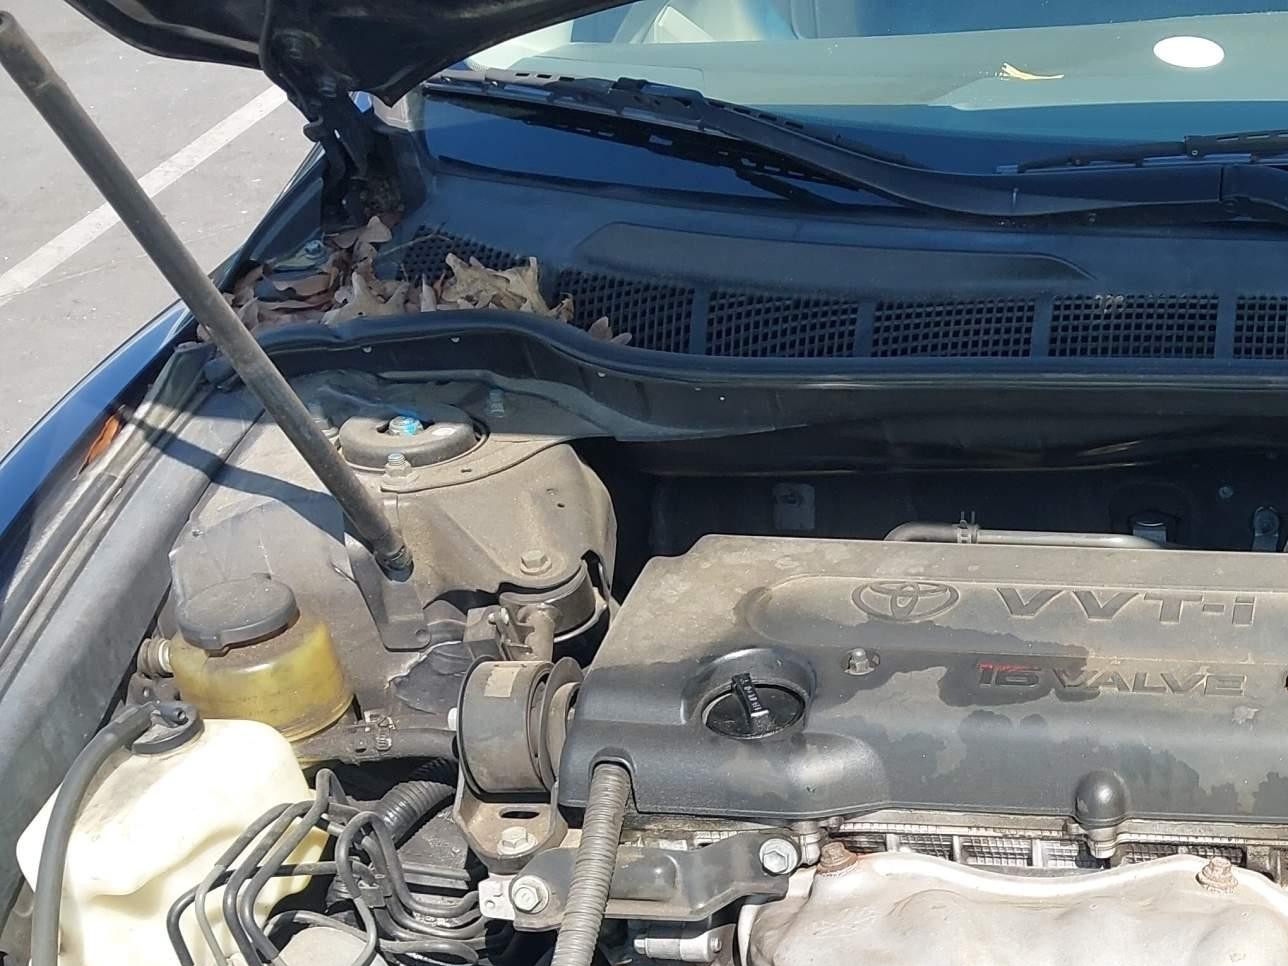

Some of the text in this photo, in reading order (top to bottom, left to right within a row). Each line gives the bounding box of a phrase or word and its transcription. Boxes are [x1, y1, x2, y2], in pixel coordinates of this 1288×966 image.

[996, 587, 1256, 627] VVT-i
[976, 662, 1248, 697] 16 VALVE
